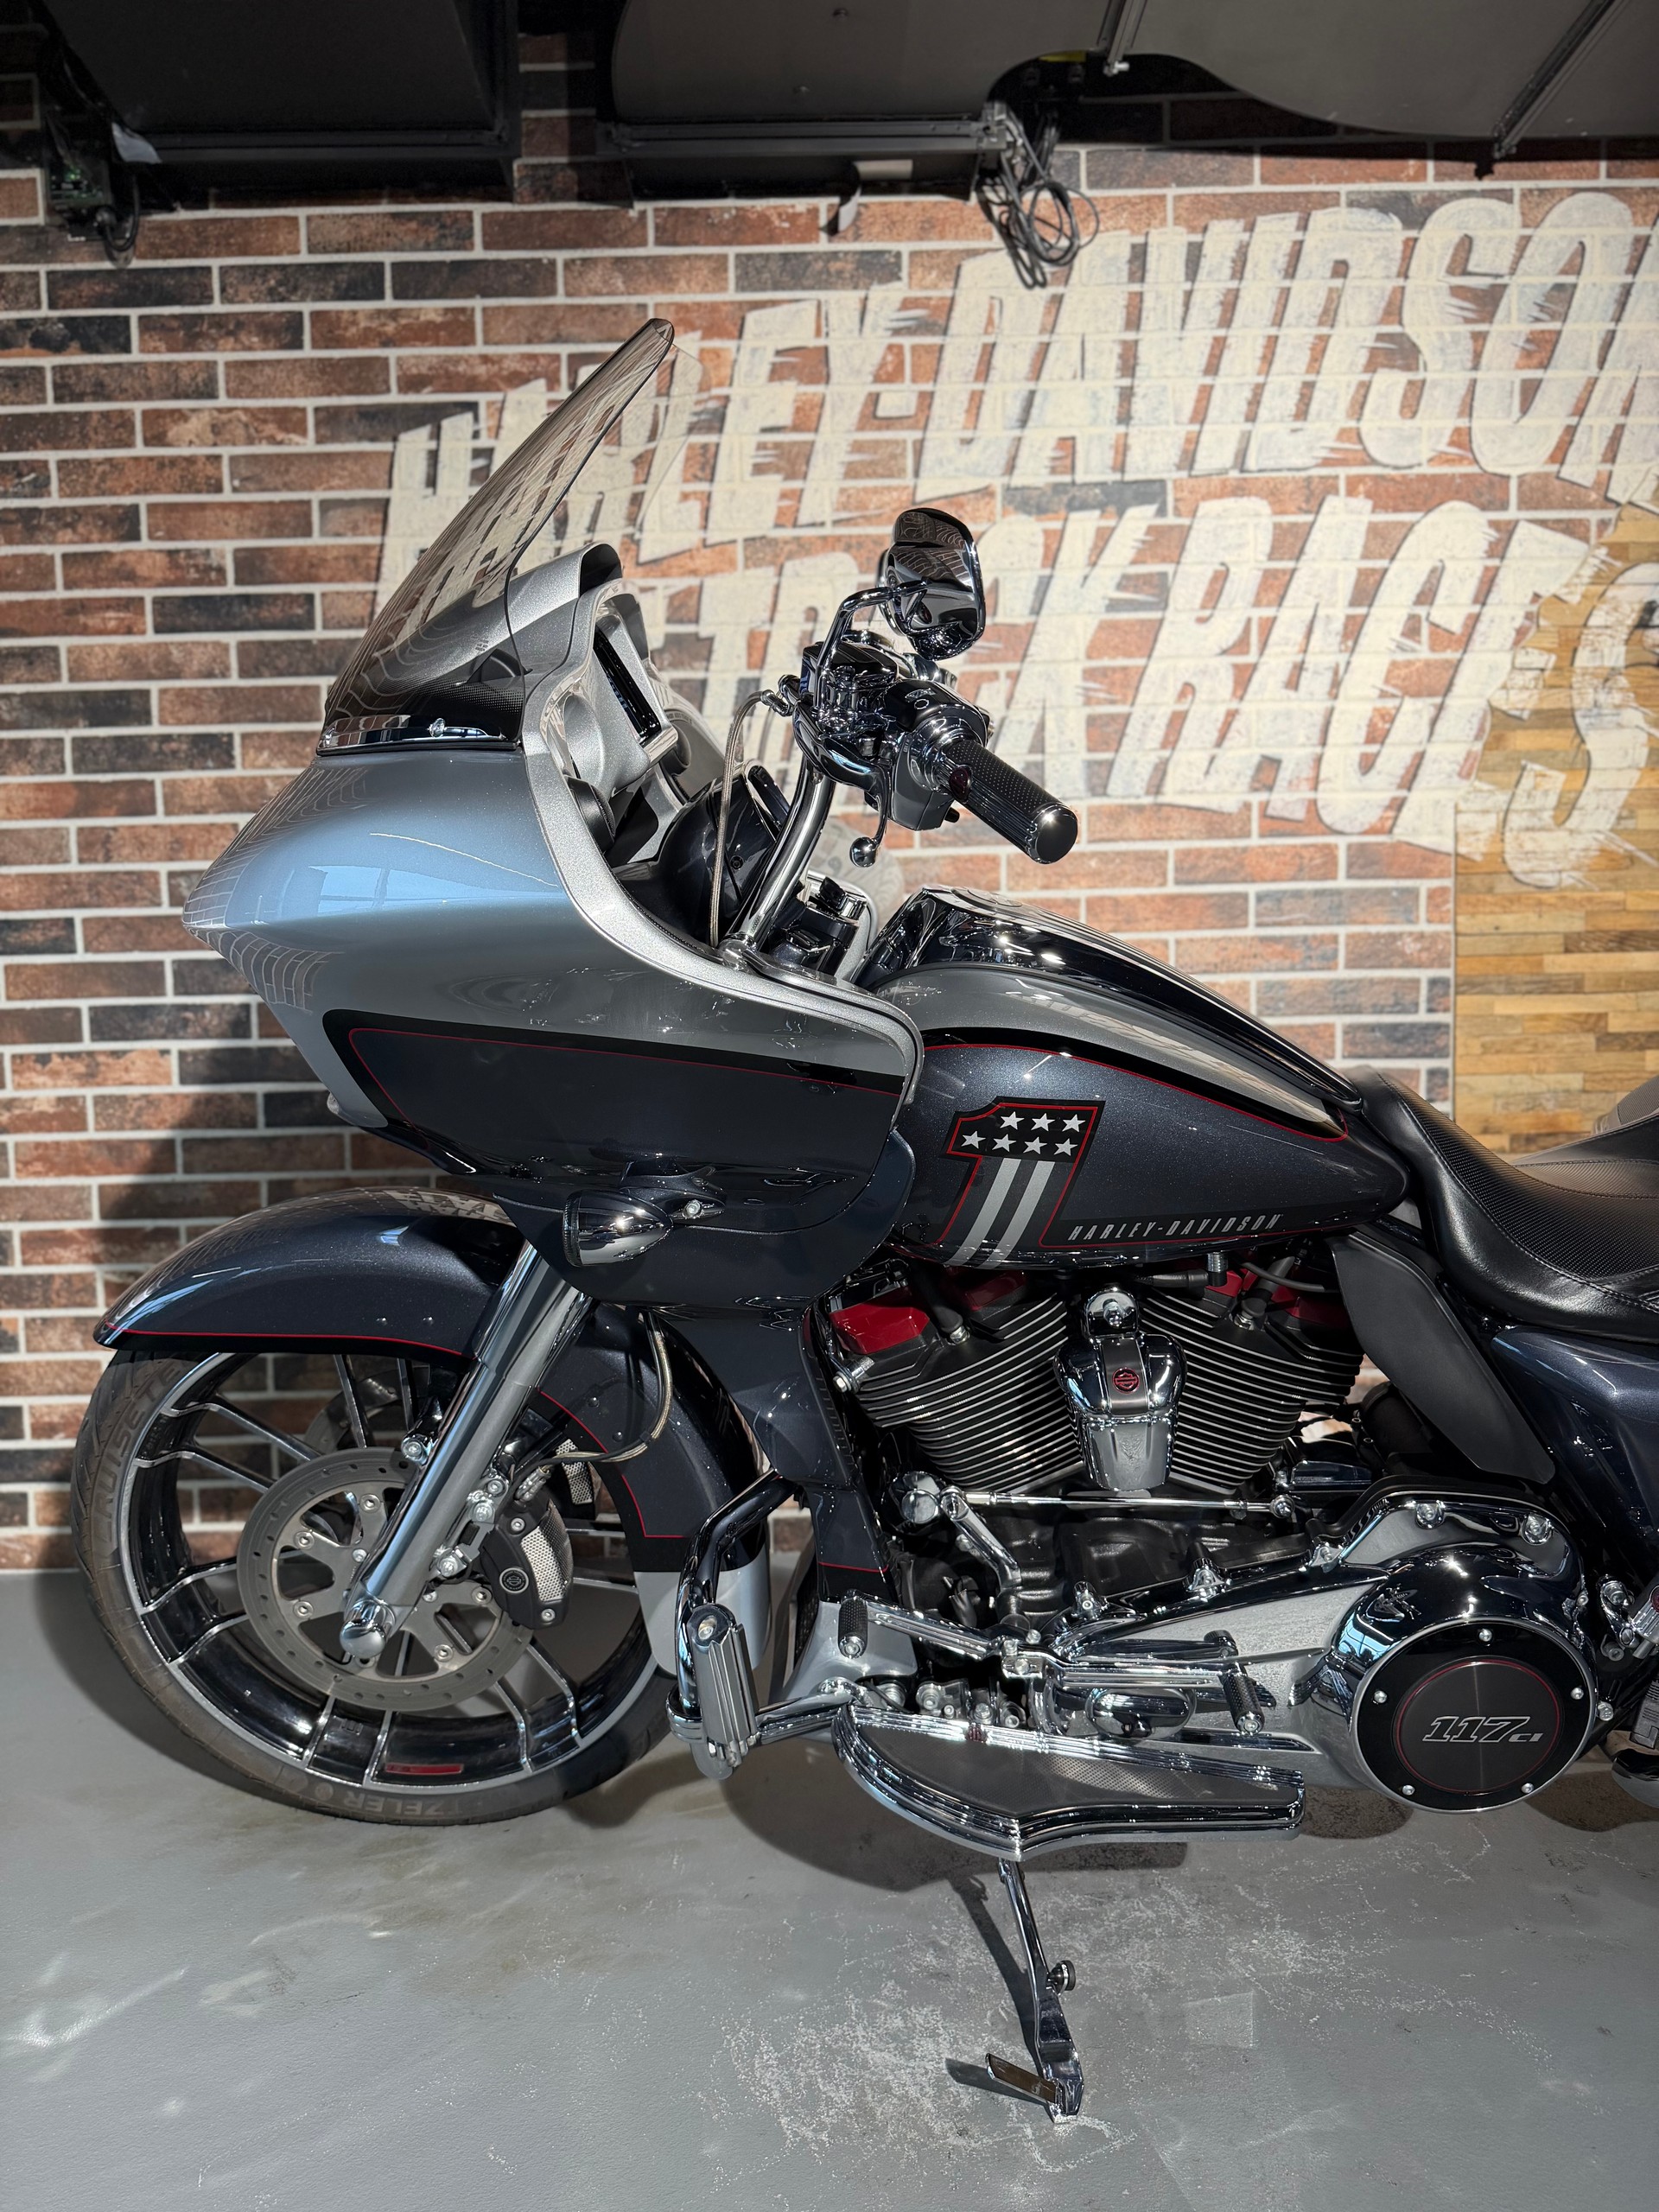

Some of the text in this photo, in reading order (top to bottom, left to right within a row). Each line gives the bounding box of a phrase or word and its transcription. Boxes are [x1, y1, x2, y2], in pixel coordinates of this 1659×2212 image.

[694, 499, 1161, 802] TRCK
[1067, 1213, 1281, 1242] HARLEY-DAVIDSON
[93, 1357, 184, 1544] CRUISETE
[342, 1788, 467, 1817] TZELER
